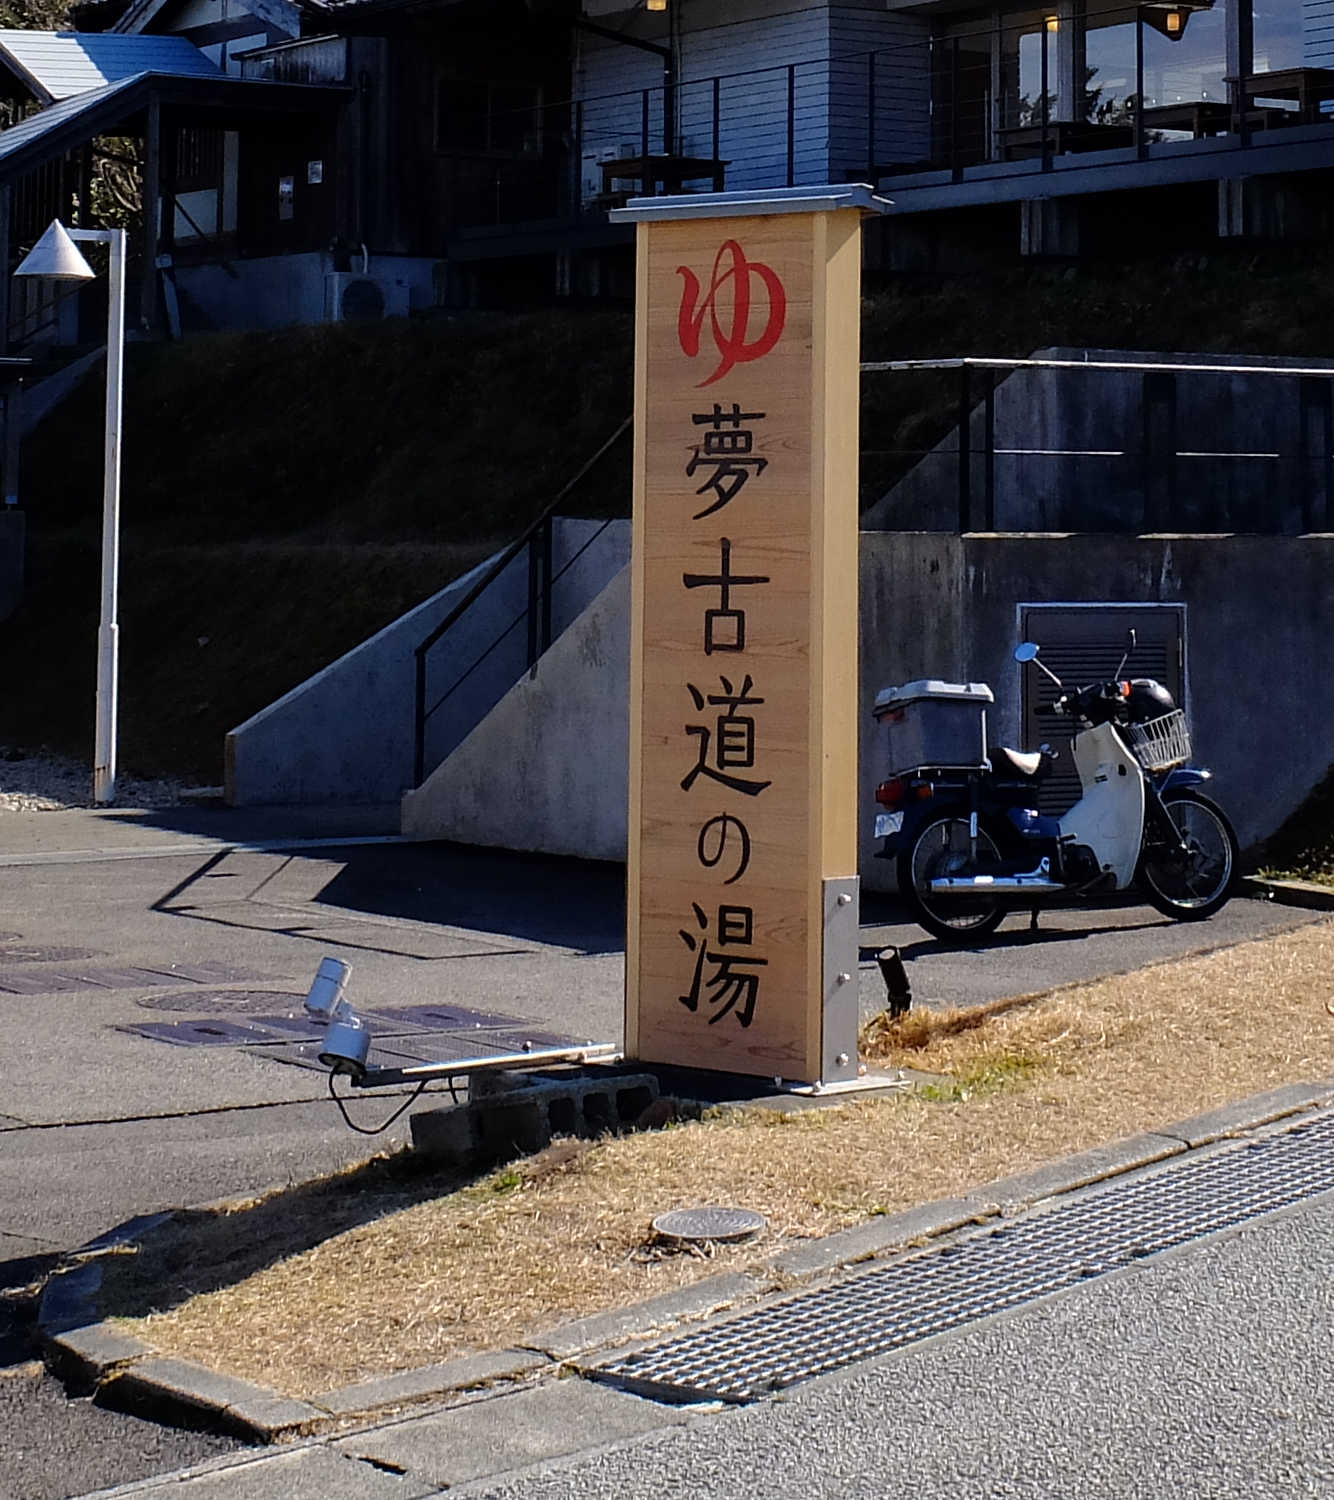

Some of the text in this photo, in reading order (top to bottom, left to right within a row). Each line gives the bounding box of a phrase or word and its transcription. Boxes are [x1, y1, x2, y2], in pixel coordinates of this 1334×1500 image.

[676, 239, 786, 388] ゆ
[679, 403, 771, 1029] 夢古道の湯
